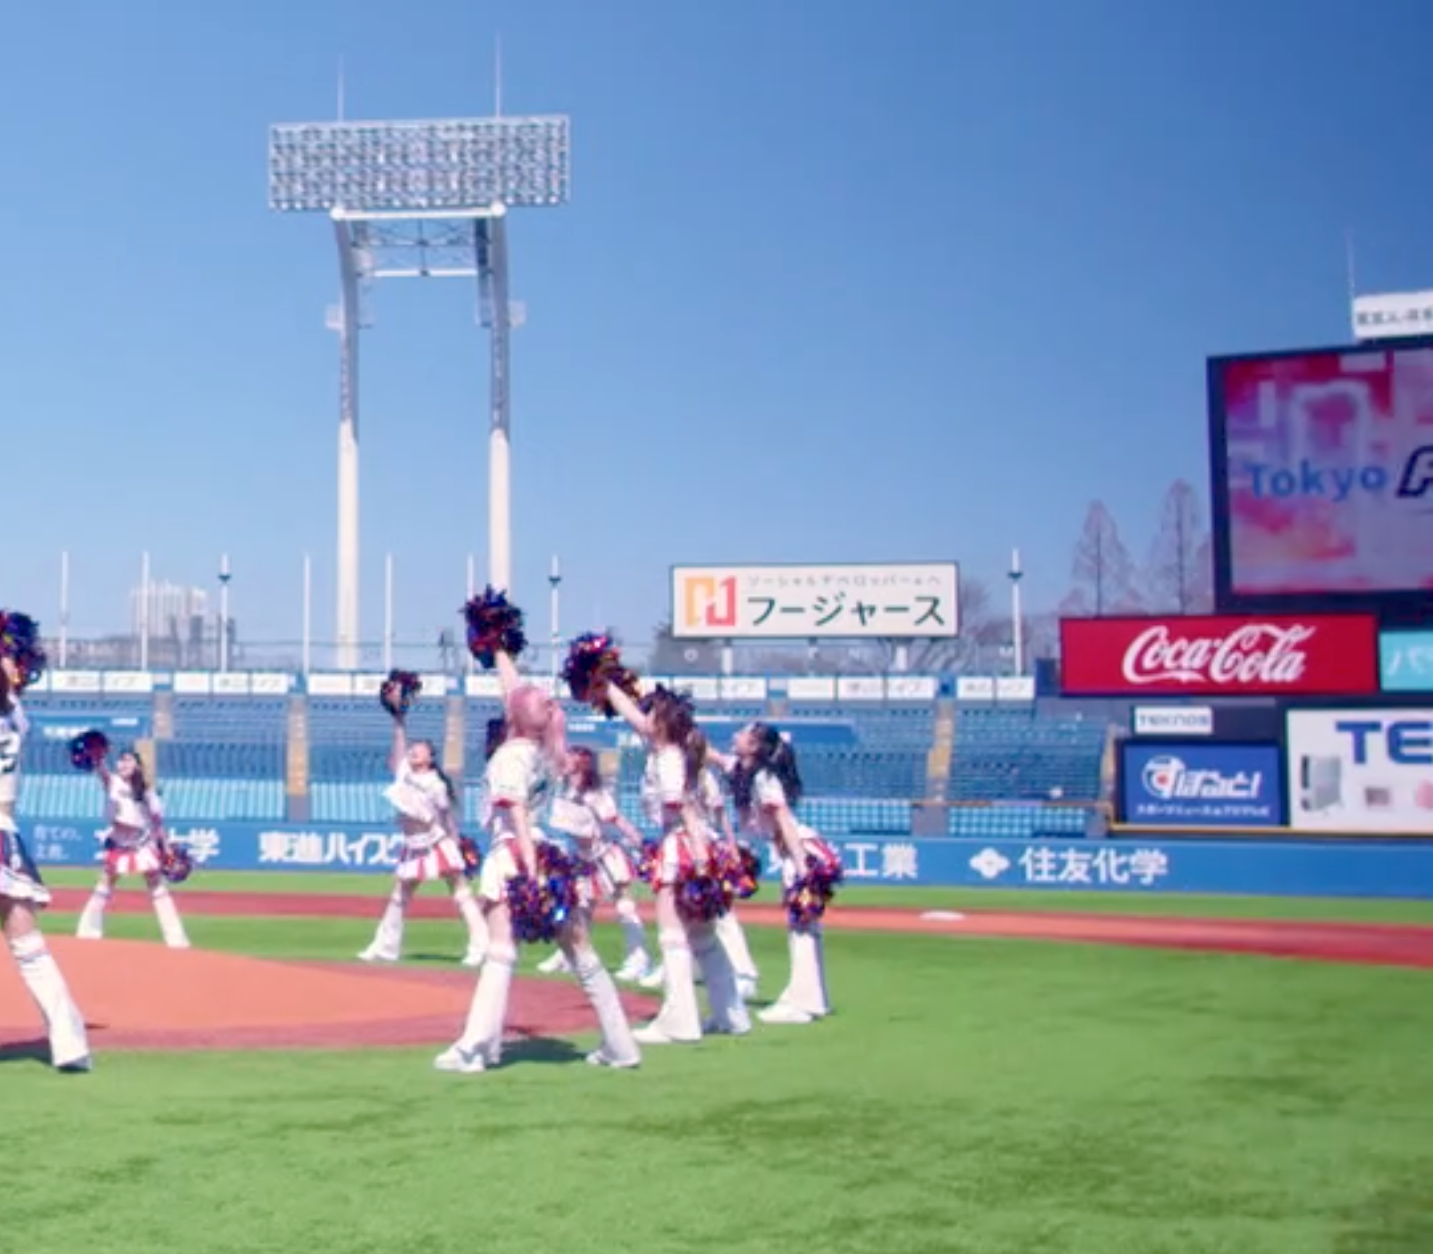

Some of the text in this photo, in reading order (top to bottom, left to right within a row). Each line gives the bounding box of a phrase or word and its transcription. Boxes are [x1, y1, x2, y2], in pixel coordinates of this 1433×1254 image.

[1243, 459, 1388, 502] Tokyo
[746, 592, 945, 627] フージャース
[1122, 623, 1315, 683] Coca-Cola
[1019, 847, 1168, 885] 住友化学
